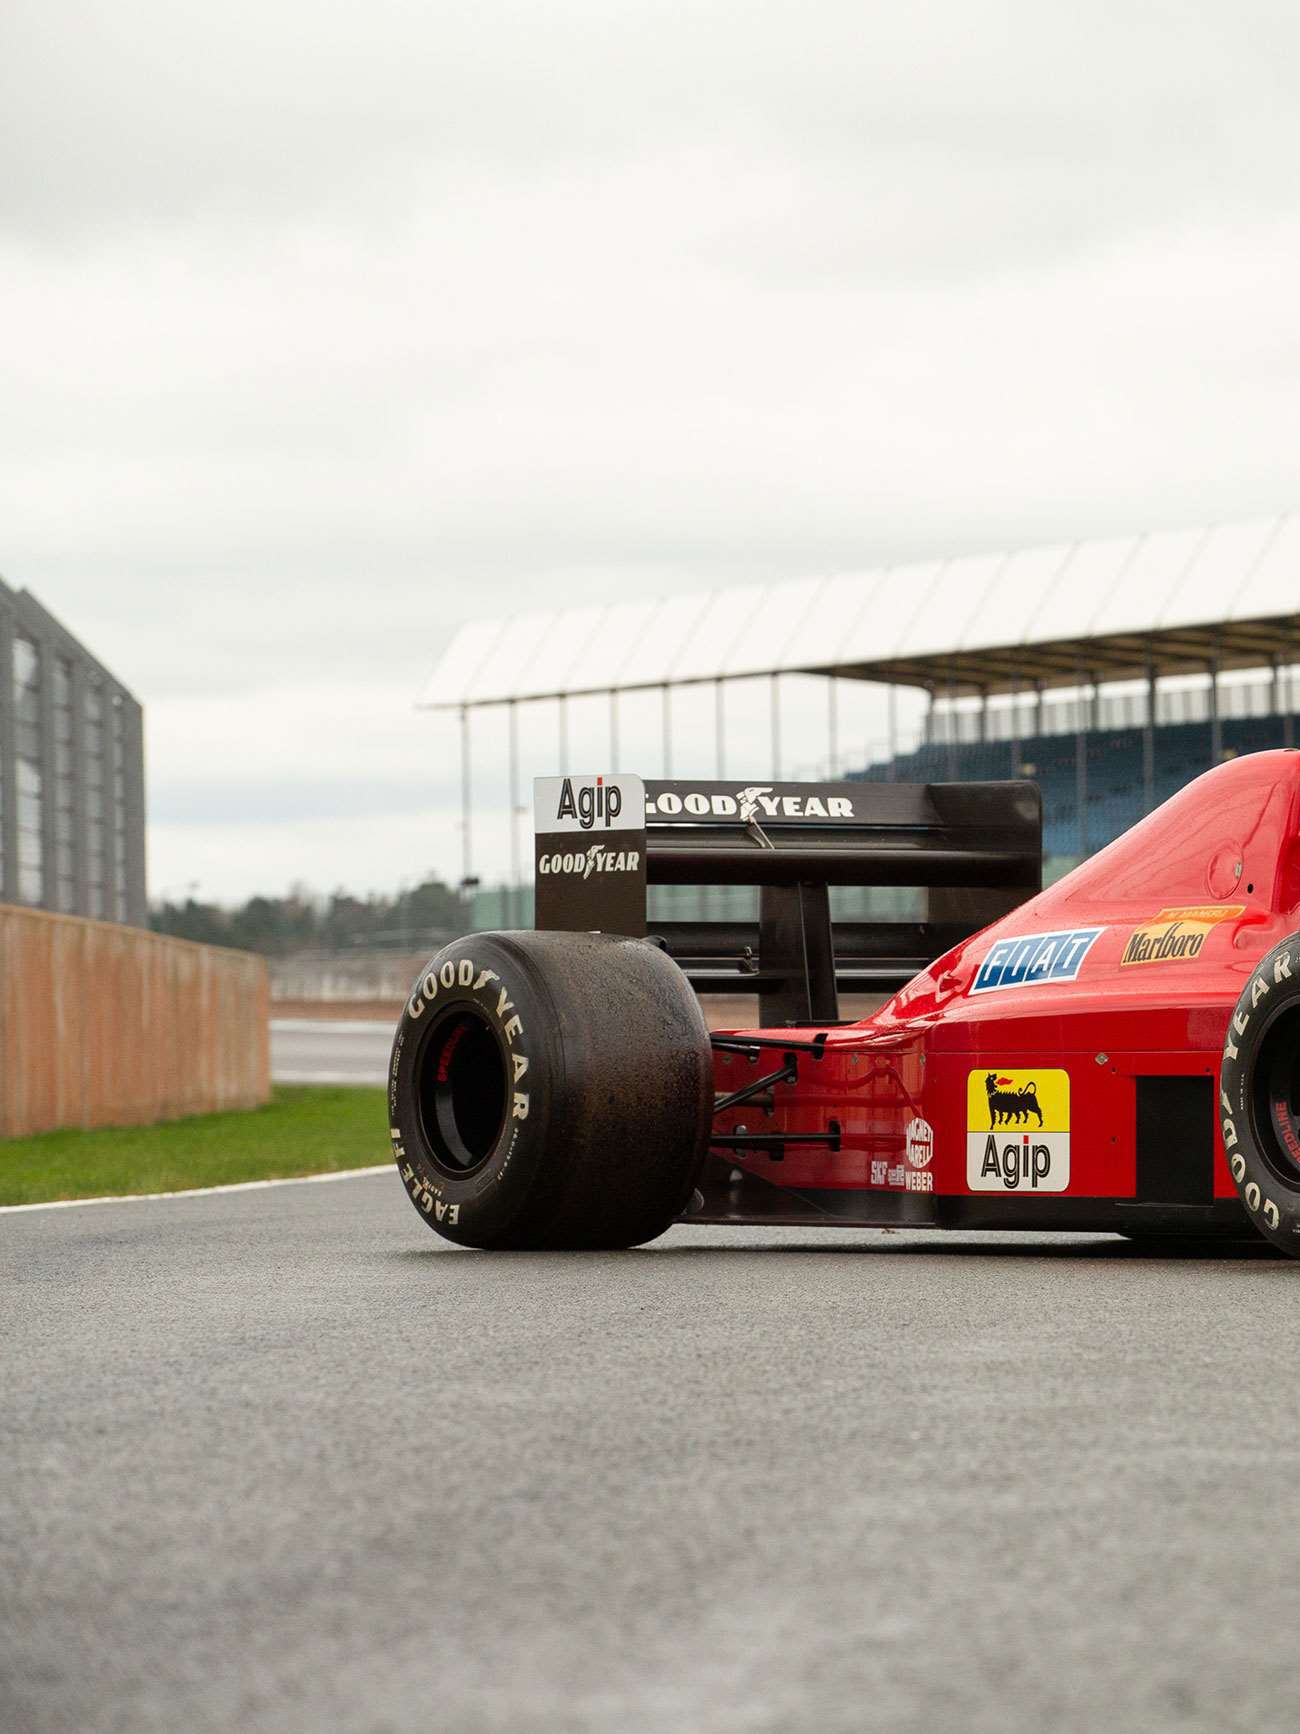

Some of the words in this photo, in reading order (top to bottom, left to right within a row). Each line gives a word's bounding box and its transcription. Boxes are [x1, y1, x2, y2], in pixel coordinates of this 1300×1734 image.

[557, 776, 622, 829] Agip
[981, 936, 1091, 984] FIAT
[1123, 922, 1204, 963] Marlboro
[905, 1171, 933, 1191] WEBER
[981, 1134, 1050, 1189] Agip
